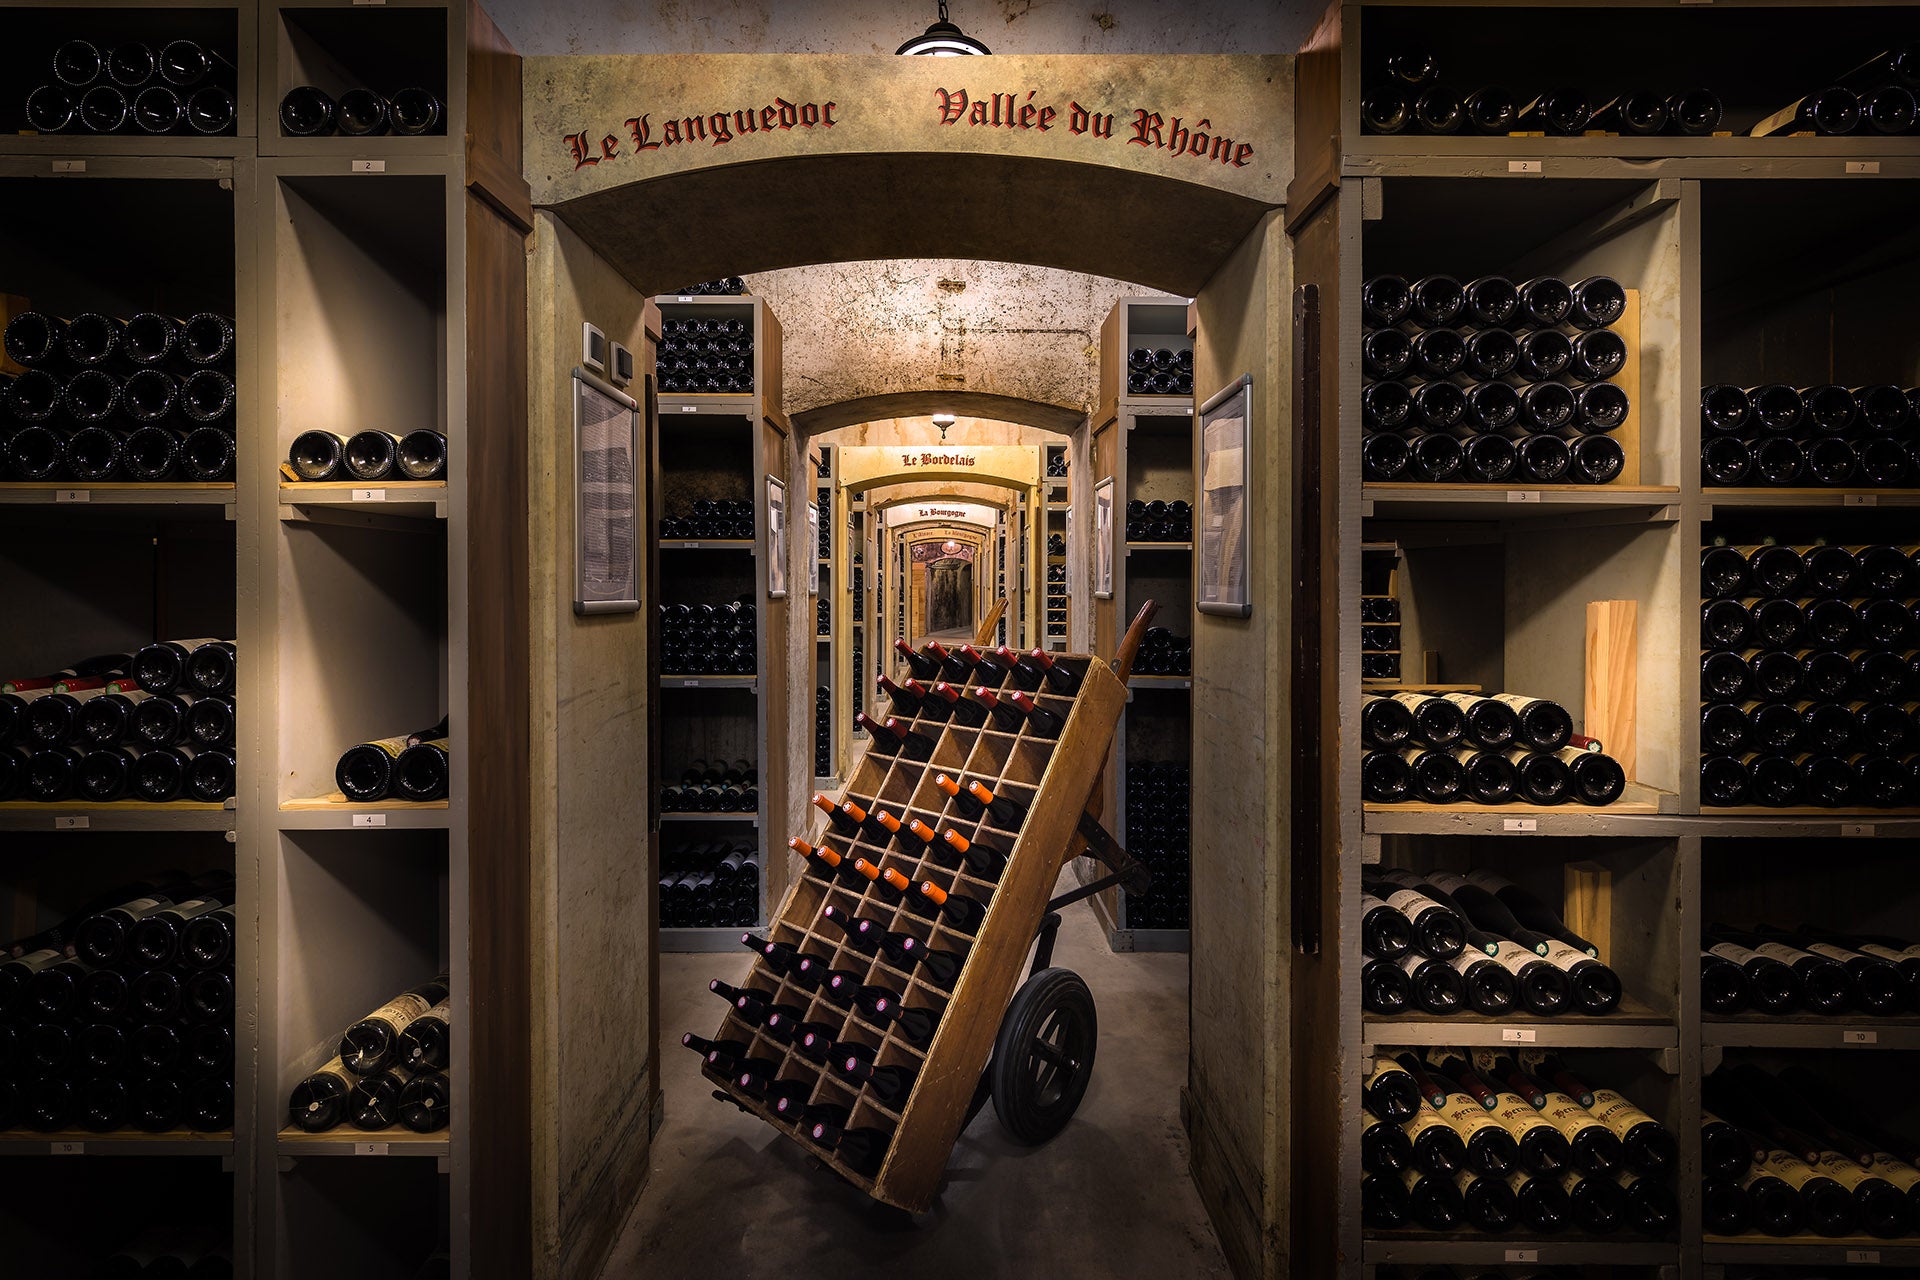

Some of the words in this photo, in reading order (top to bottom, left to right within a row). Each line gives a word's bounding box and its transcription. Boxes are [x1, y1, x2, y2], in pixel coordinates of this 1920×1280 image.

[563, 130, 621, 171] Le
[624, 97, 839, 151] Languedoc
[934, 87, 1057, 136] Vallée
[1069, 101, 1114, 140] du
[1128, 109, 1254, 168] Rhône
[902, 454, 917, 467] Le
[920, 453, 976, 467] Bordelais
[919, 509, 928, 517] La
[930, 508, 966, 518] Bourgogne
[1857, 1033, 1867, 1041] 10
